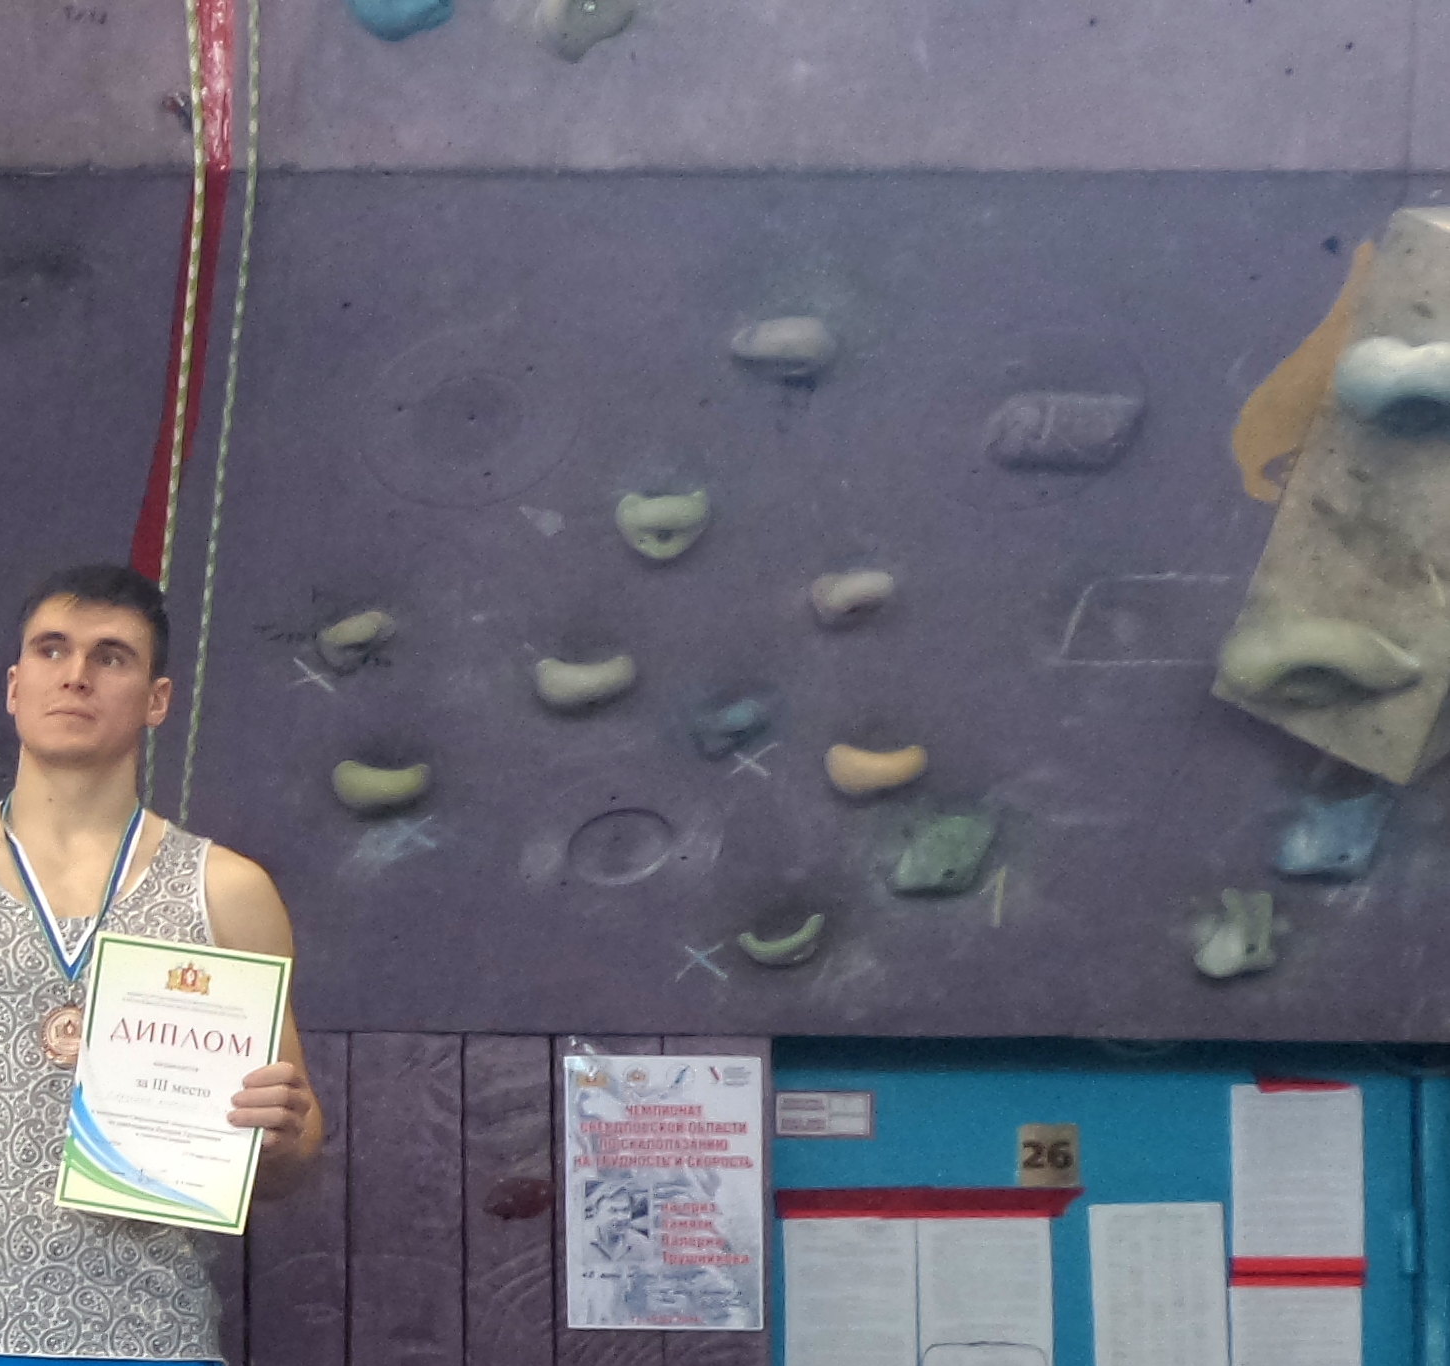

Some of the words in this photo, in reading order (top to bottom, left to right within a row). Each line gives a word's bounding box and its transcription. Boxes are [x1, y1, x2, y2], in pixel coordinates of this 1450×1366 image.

[110, 1017, 252, 1057] ДИПЛОМ
[135, 1078, 148, 1088] за
[152, 1078, 169, 1091] III
[172, 1084, 212, 1098] место
[625, 1104, 703, 1117] ЧЕМПИОНАТ
[1021, 1140, 1074, 1170] 26
